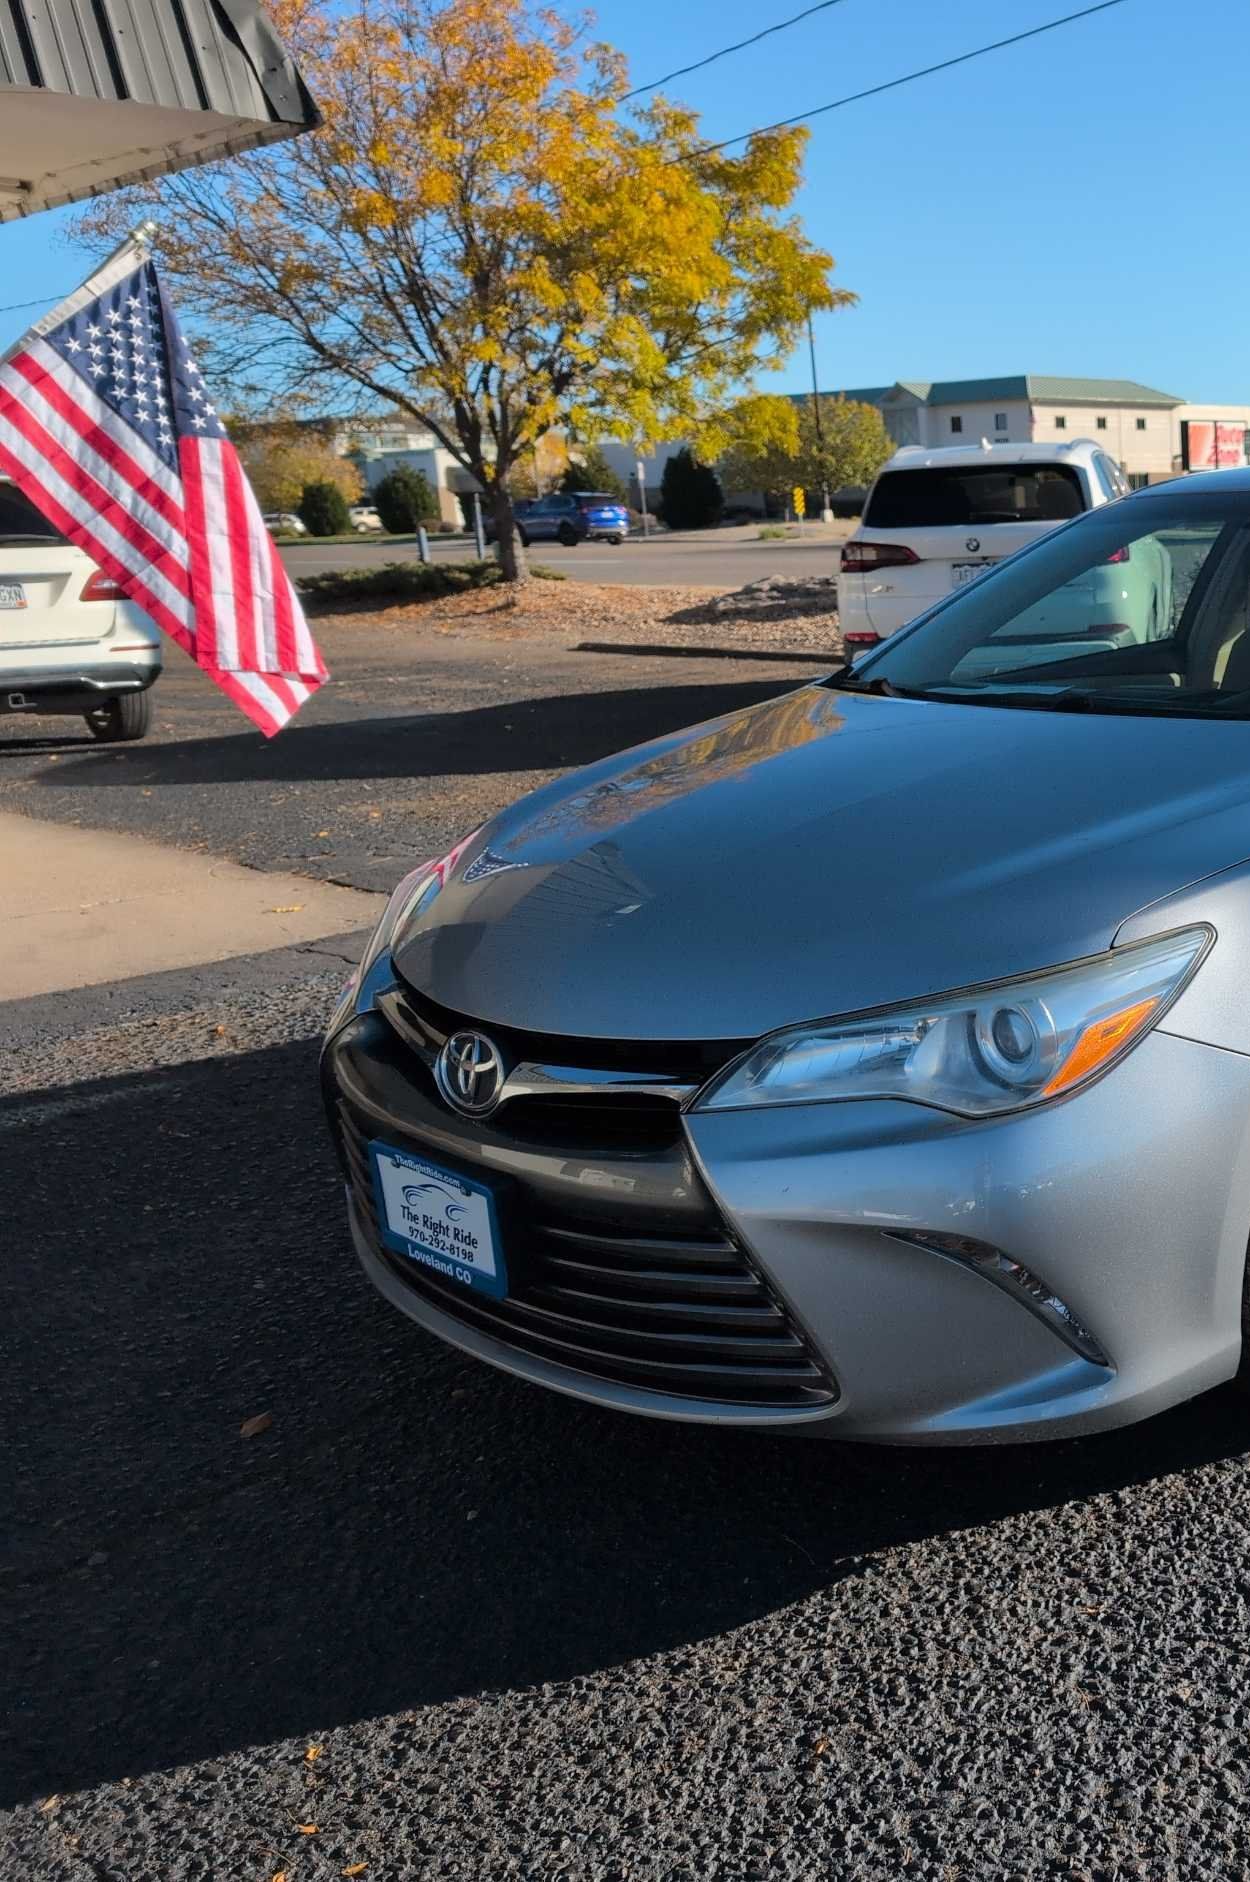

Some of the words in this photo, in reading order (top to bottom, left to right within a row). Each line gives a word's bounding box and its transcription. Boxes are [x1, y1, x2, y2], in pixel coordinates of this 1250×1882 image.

[394, 1154, 461, 1187] TheRightRide.com
[400, 1205, 420, 1225] The
[422, 1214, 450, 1239] Right
[453, 1227, 478, 1249] Ride
[408, 1225, 474, 1263] 970-292-8198
[407, 1244, 454, 1277] Loveland
[455, 1267, 472, 1285] CO
